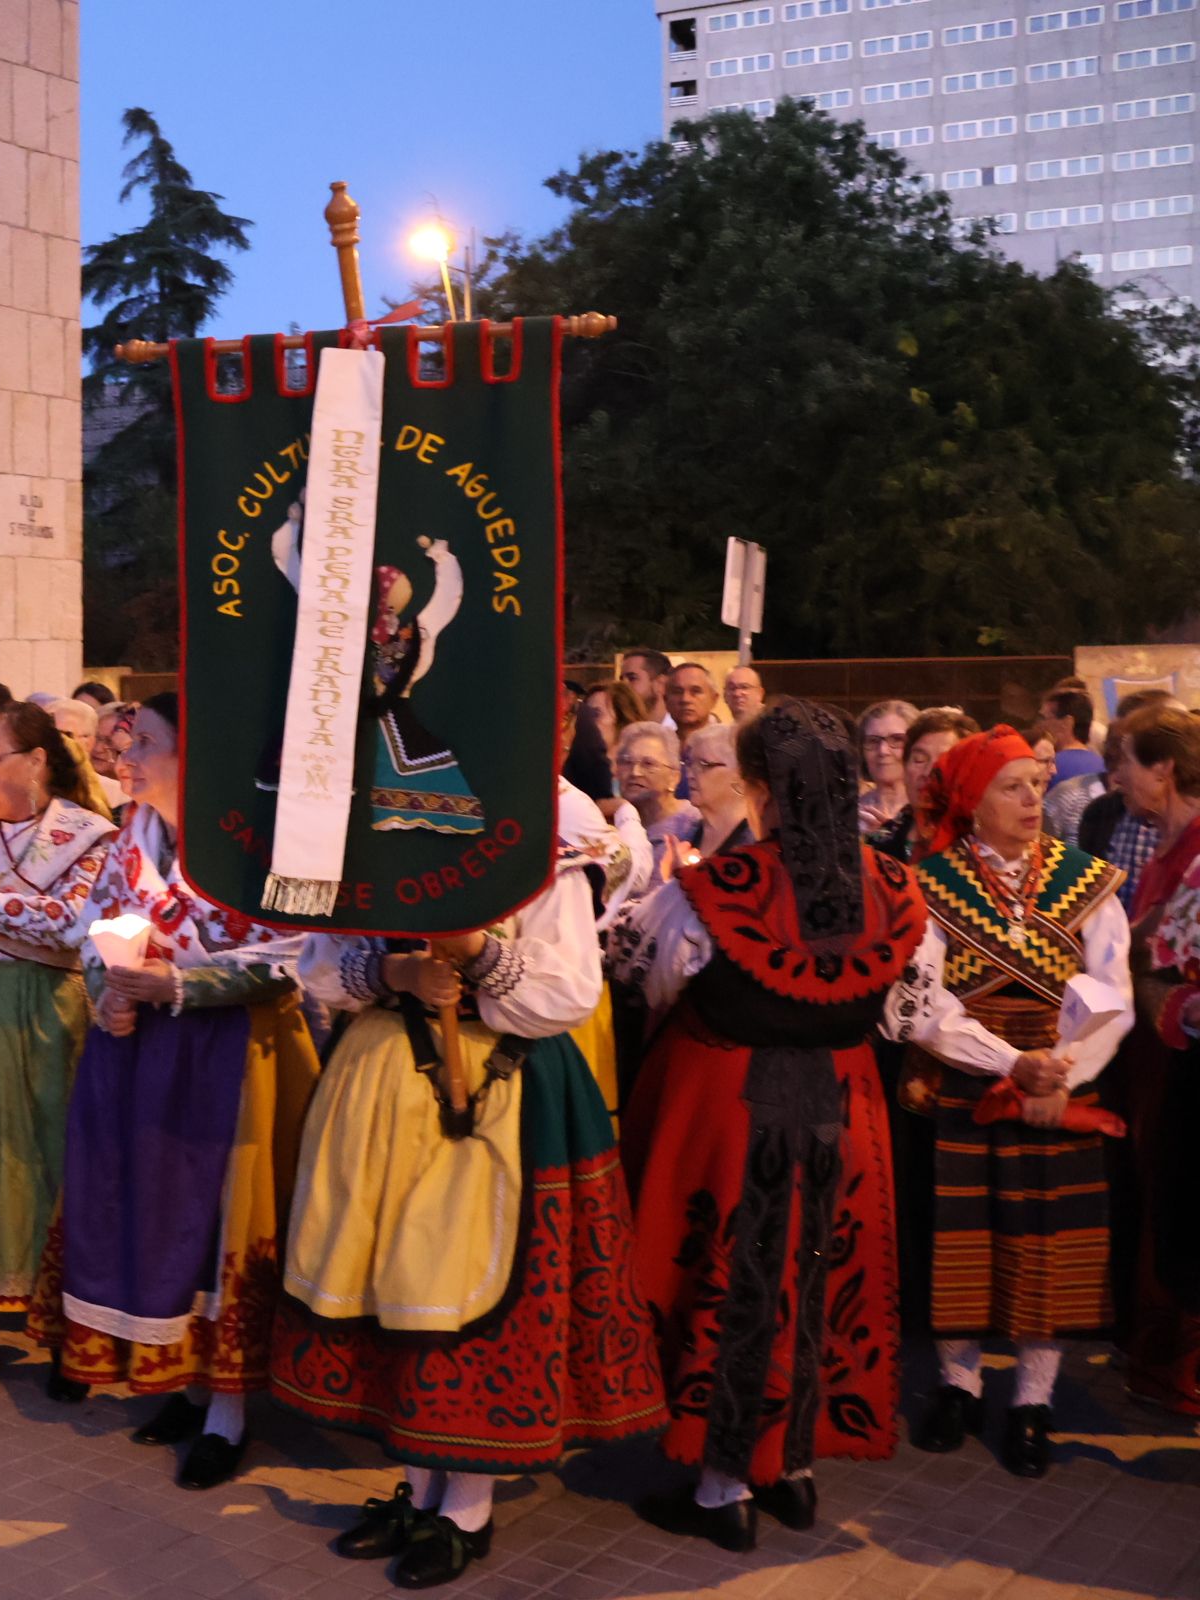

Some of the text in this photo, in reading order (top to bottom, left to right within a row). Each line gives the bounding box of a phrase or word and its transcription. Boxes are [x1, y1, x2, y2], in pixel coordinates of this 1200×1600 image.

[237, 432, 310, 518] CULTU
[395, 425, 446, 464] DE
[445, 462, 523, 617] AGUEDAS
[324, 496, 368, 540] SRA
[316, 609, 351, 640] DE
[306, 645, 354, 747] FRANCIA
[395, 818, 523, 906] OBRERO
